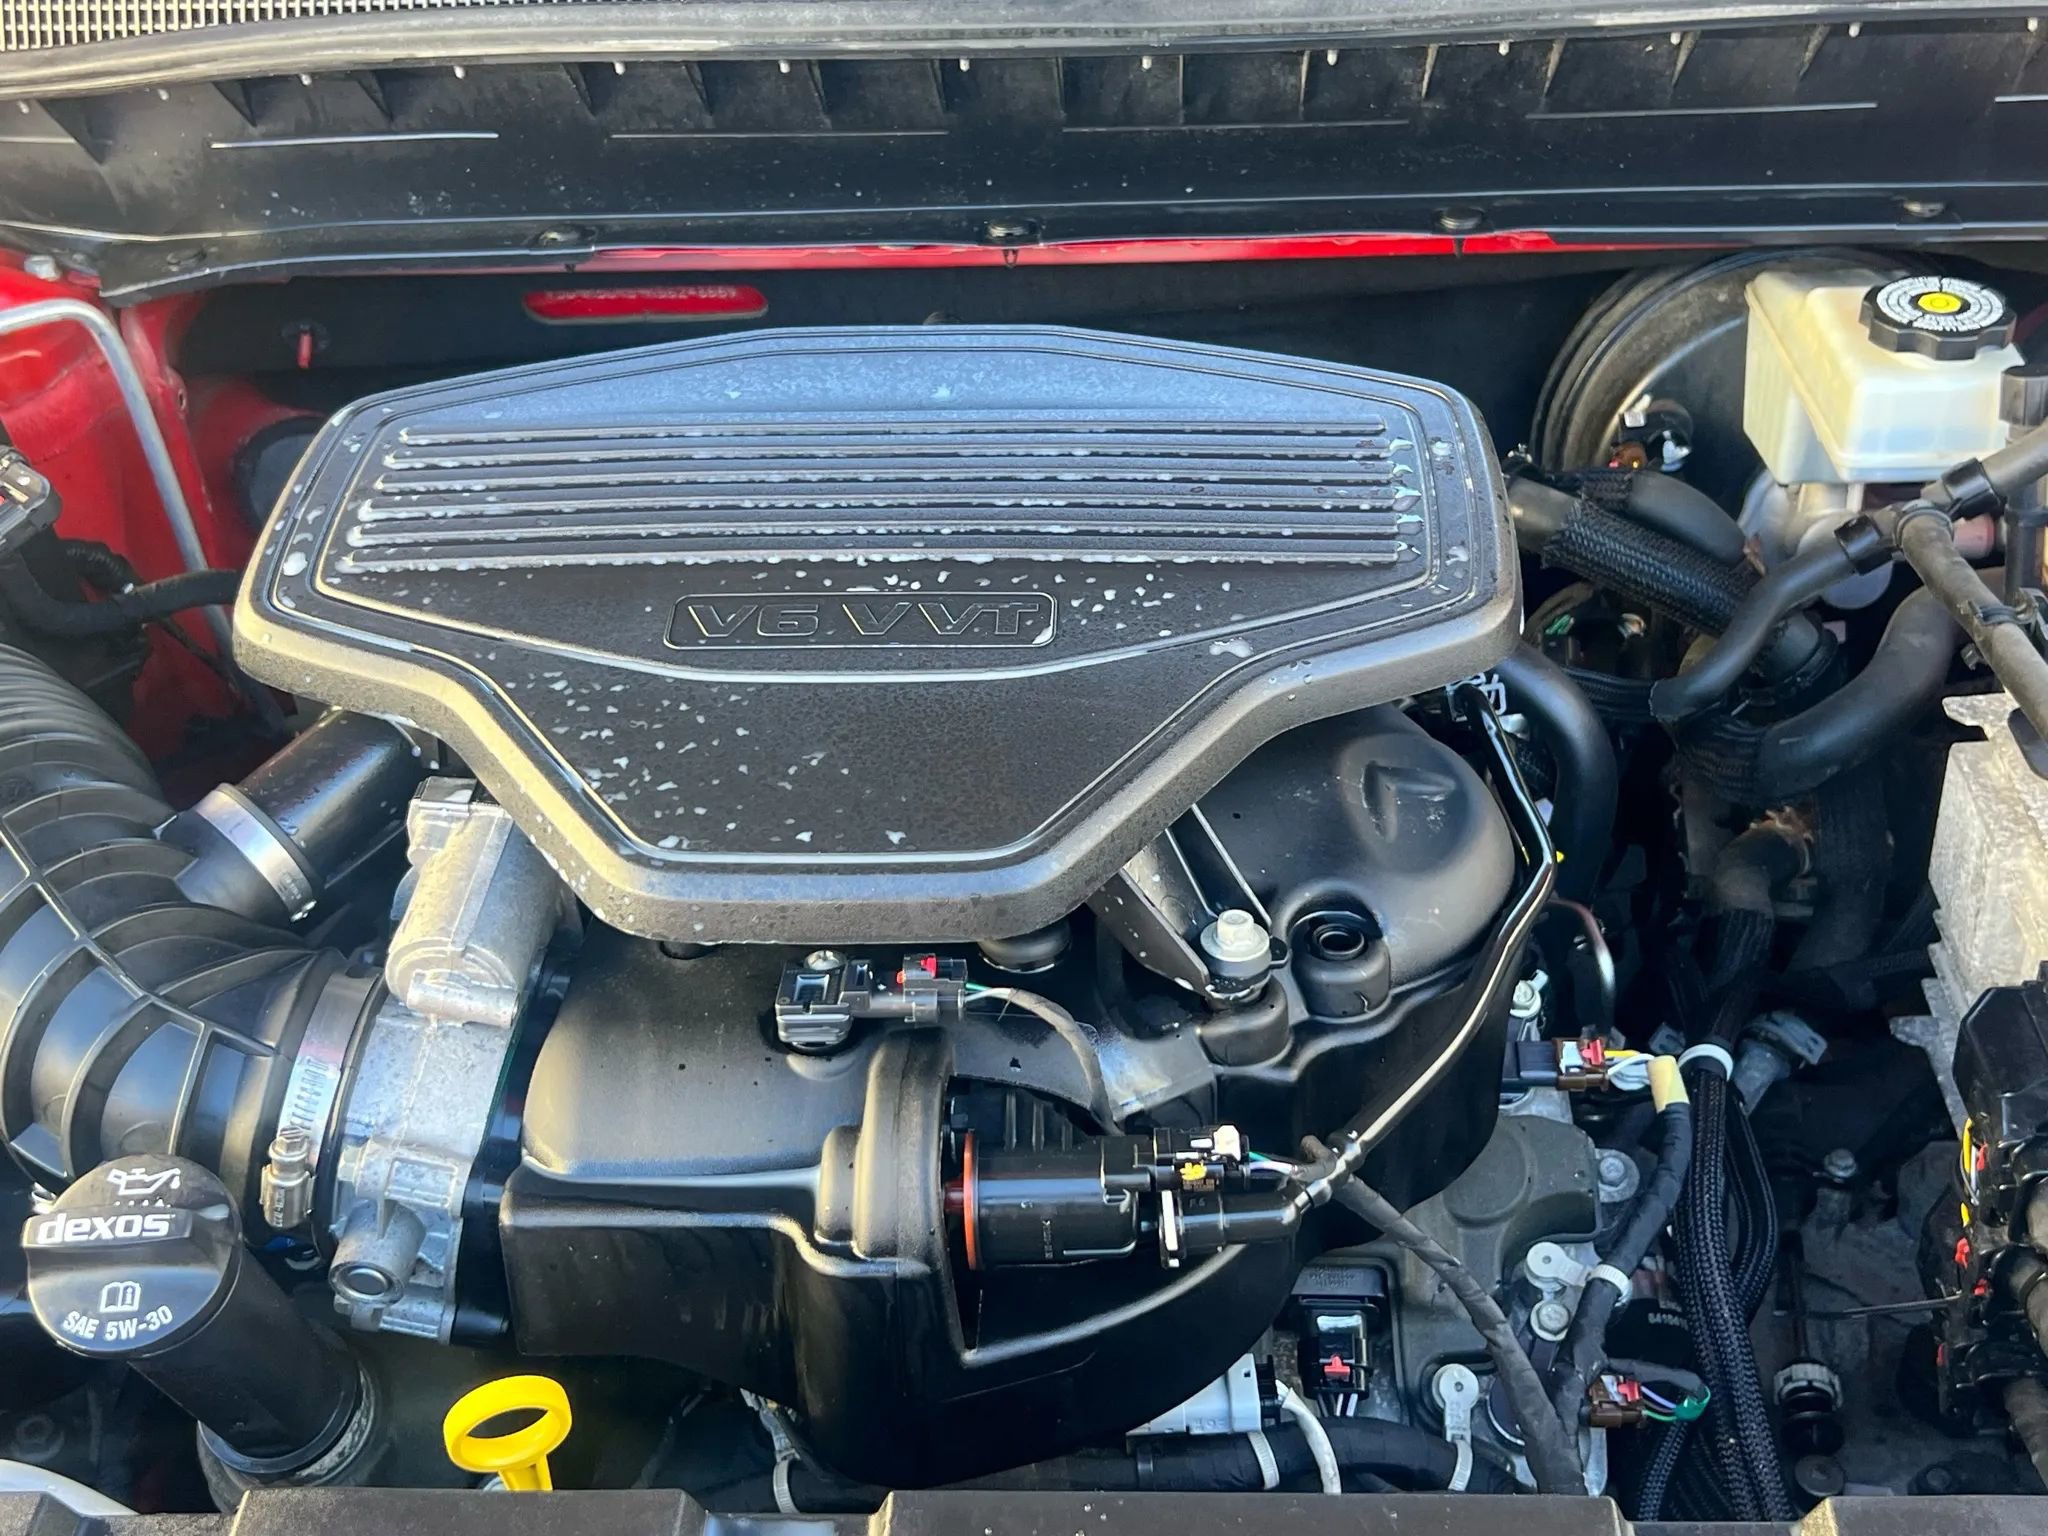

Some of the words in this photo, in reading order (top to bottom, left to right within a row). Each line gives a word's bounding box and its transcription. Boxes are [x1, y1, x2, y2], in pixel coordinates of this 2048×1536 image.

[688, 604, 819, 637] V6
[842, 602, 1040, 636] VVT
[37, 1213, 170, 1244] dexos
[63, 1311, 99, 1338] SAE
[105, 1305, 173, 1341] 5W-30
